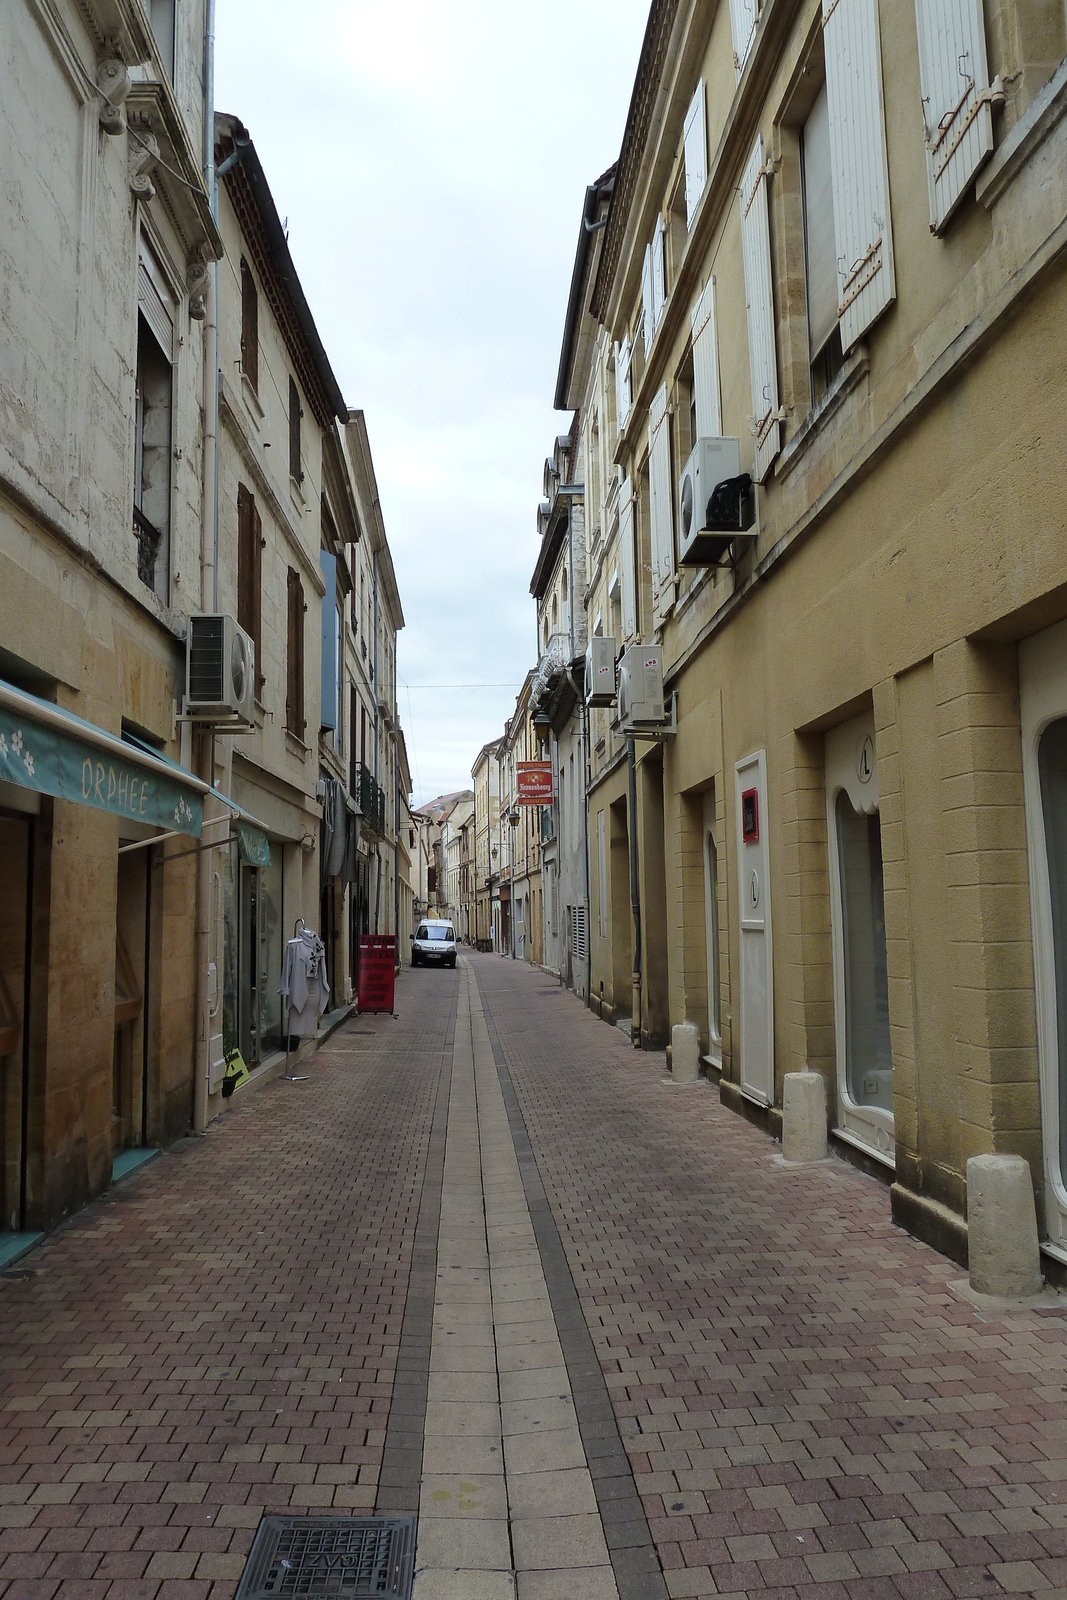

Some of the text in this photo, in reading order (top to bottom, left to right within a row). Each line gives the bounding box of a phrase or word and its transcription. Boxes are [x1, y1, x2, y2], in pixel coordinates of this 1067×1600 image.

[82, 757, 149, 815] ORPHEE
[519, 783, 551, 792] Kronenbourg
[361, 938, 396, 946] TATTOO
